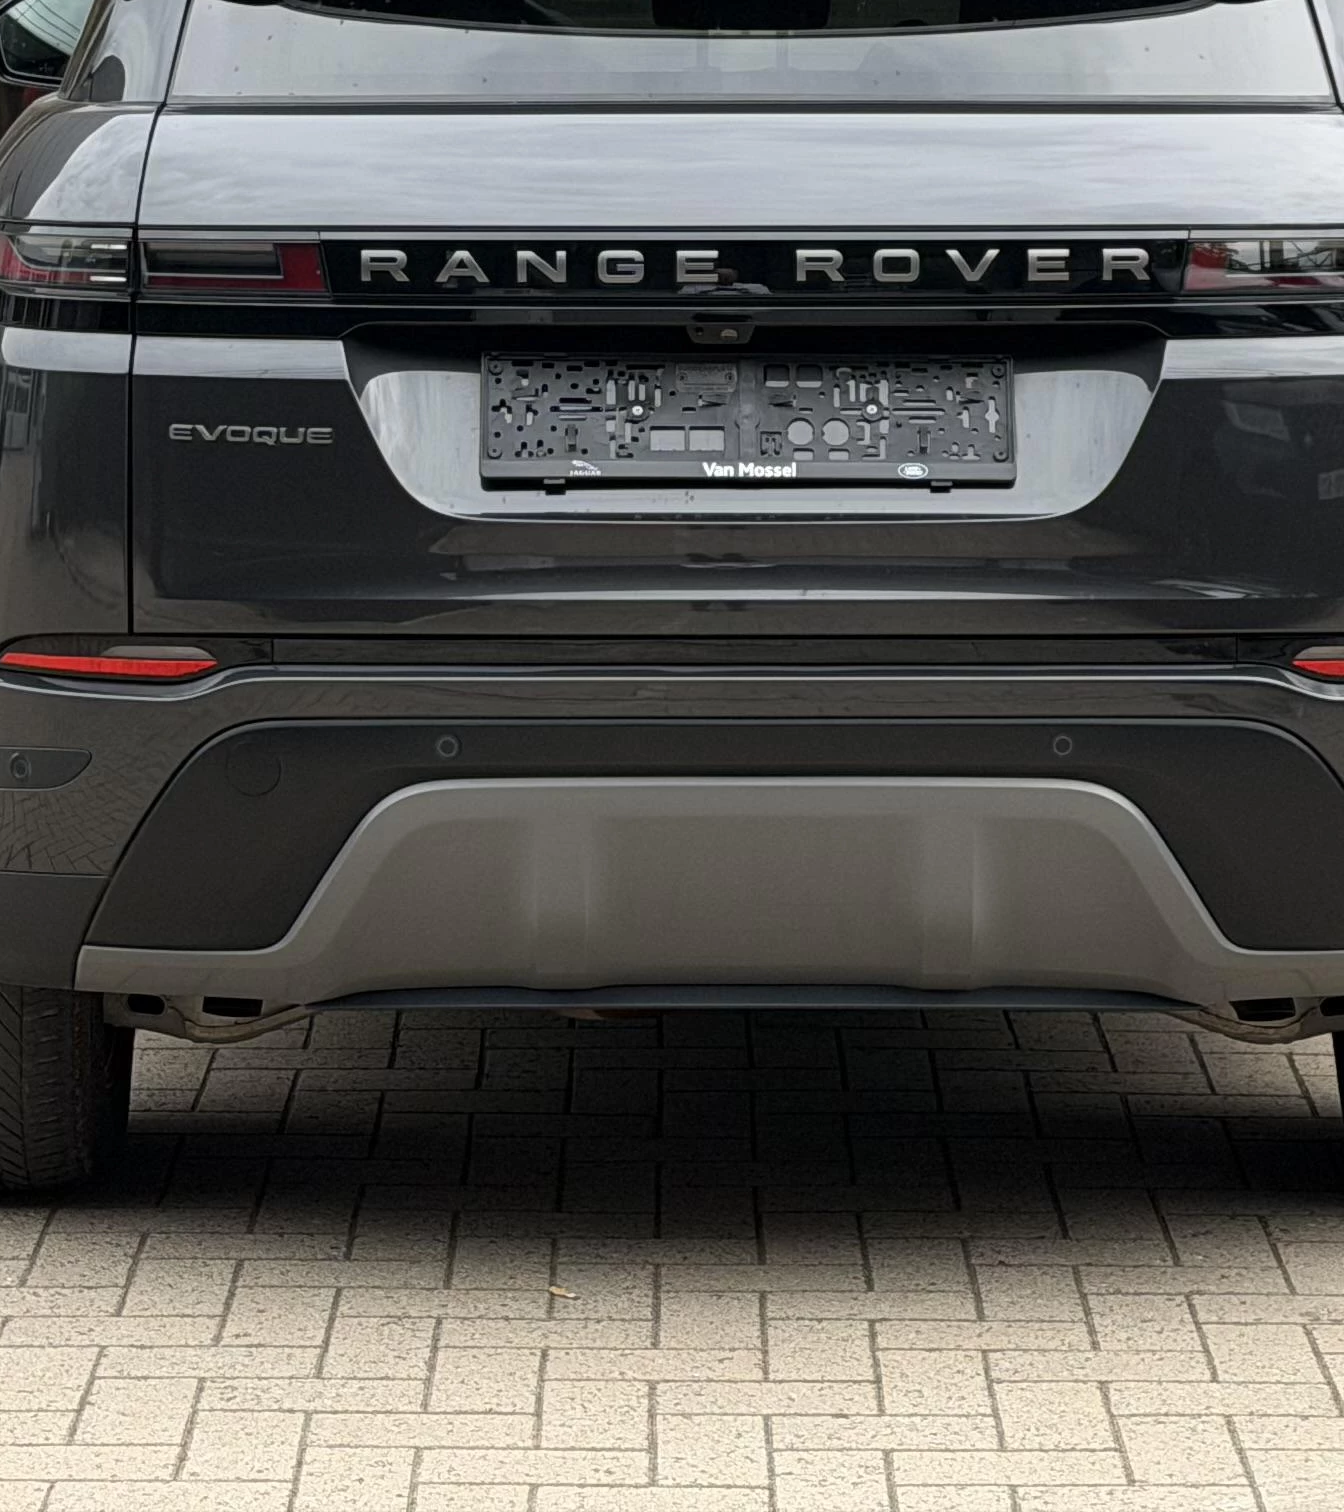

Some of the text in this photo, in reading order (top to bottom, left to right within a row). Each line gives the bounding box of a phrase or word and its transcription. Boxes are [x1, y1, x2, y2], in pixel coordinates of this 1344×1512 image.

[360, 248, 1151, 284] RANGE ROVER
[169, 423, 333, 445] EVOQUE
[702, 461, 797, 477] Van Mossel
